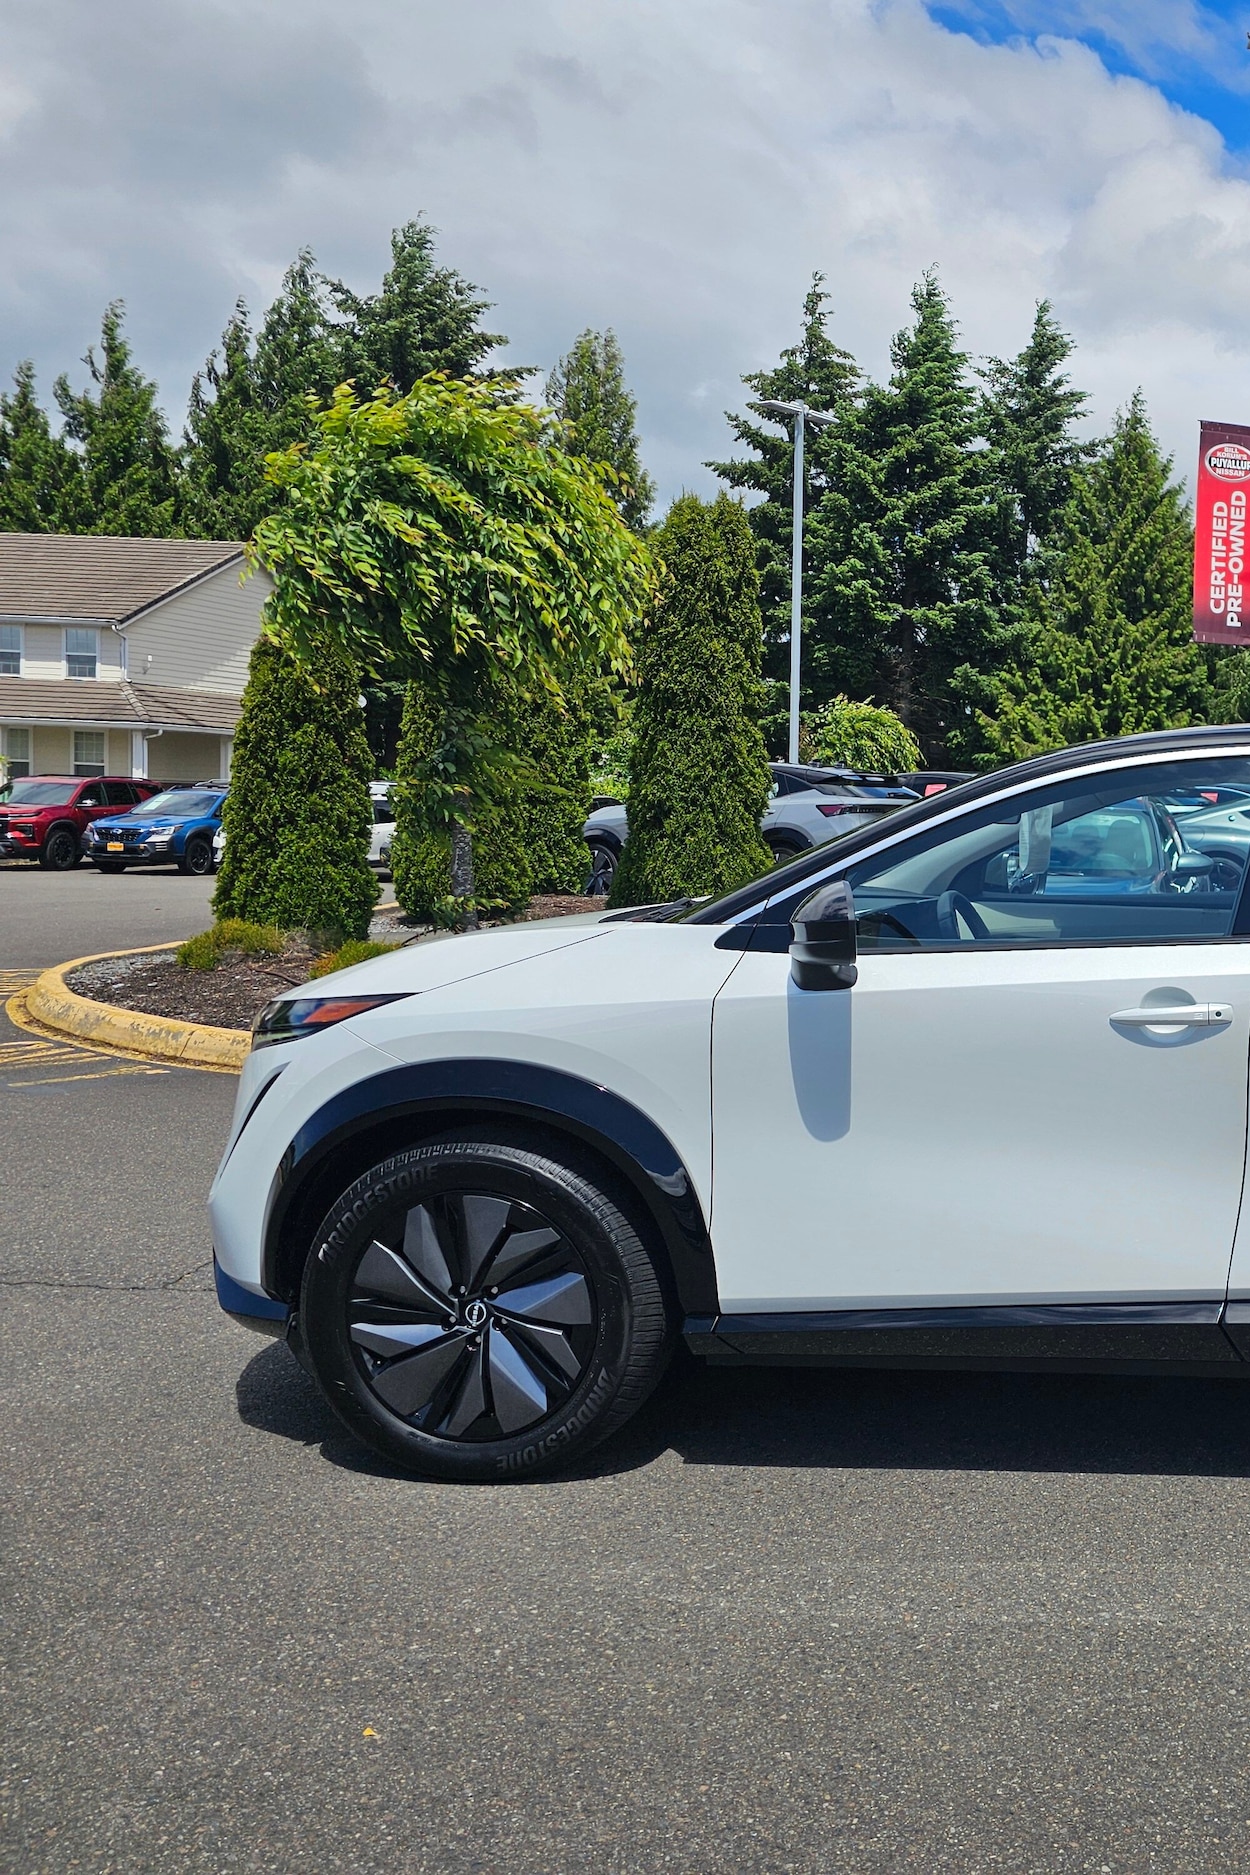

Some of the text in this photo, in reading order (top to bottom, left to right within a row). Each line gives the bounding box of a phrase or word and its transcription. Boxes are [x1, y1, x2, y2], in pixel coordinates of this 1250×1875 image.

[1216, 468, 1245, 476] NISSAN
[1210, 501, 1228, 614] CERTIFIED
[1226, 490, 1247, 628] PRE-OWNED
